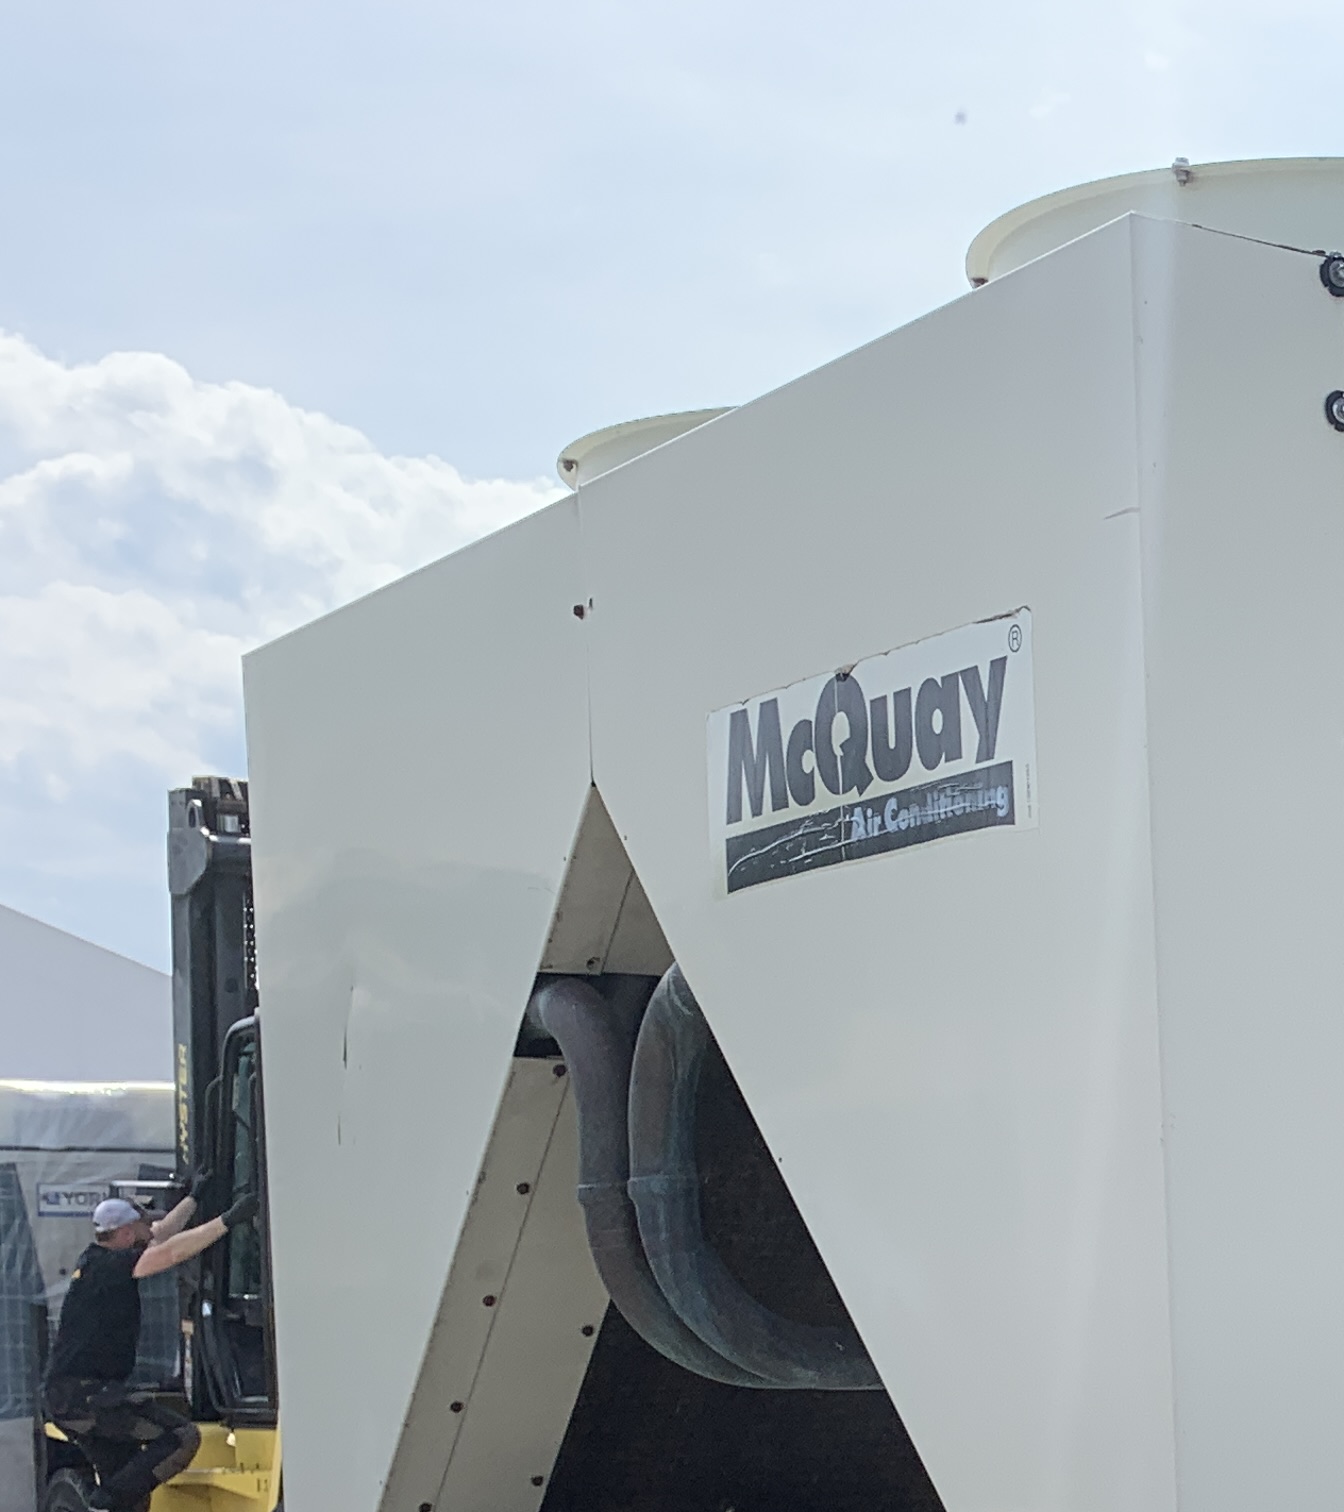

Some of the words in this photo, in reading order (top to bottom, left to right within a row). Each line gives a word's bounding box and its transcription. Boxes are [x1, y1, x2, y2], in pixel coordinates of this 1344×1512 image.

[726, 655, 1008, 826] McQuay
[851, 806, 882, 841] Air
[884, 785, 1009, 834] Conditioning
